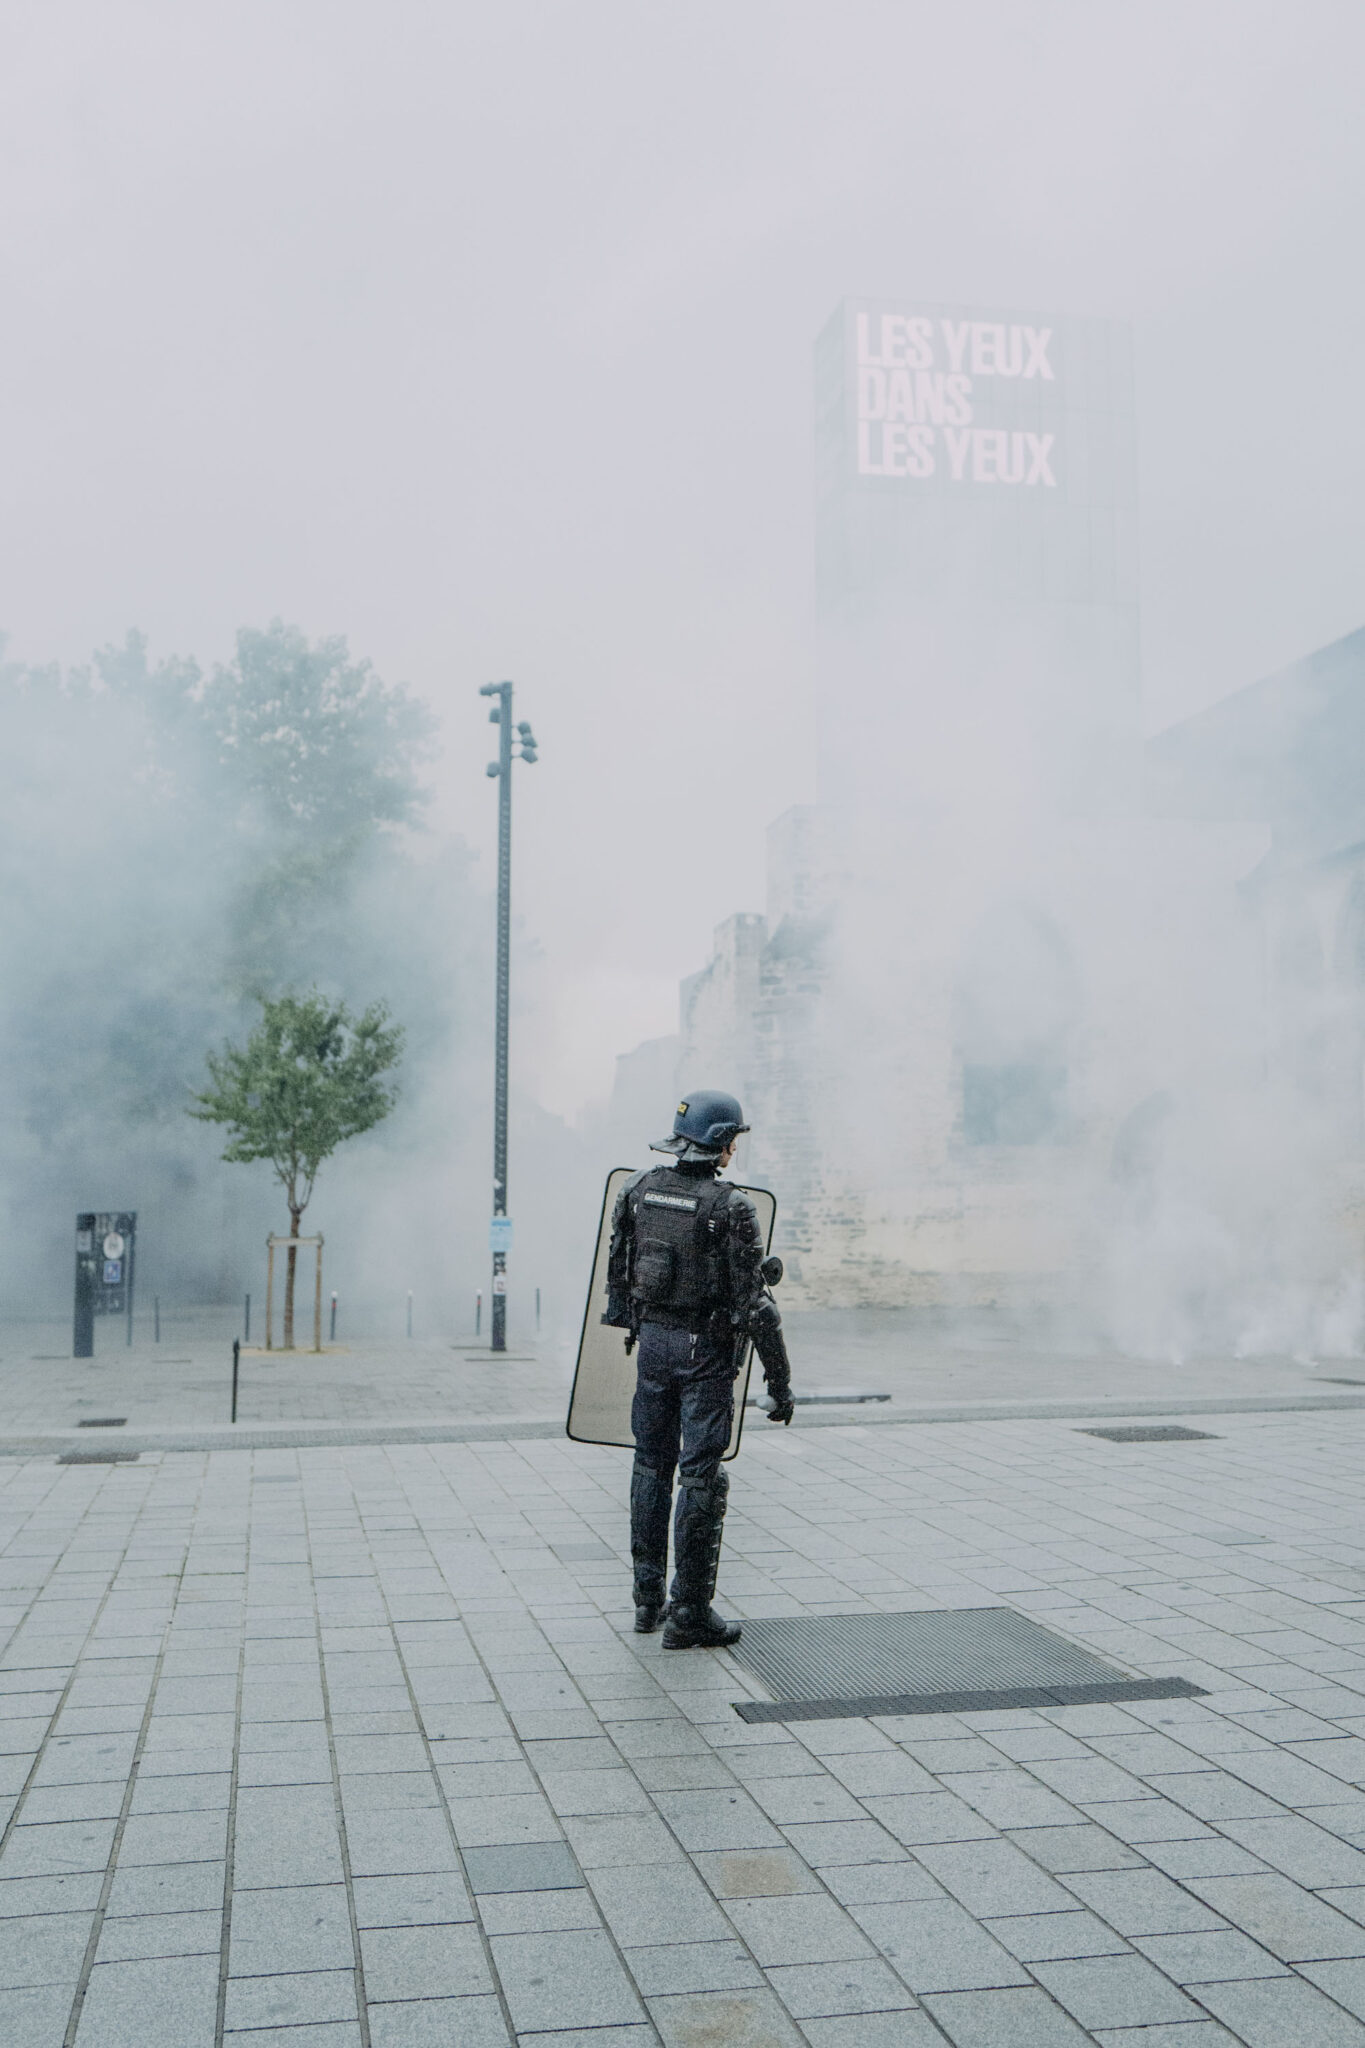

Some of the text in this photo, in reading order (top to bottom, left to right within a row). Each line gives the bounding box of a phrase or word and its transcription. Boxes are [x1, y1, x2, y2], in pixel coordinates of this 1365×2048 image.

[857, 313, 1054, 380] LES YEUX
[858, 367, 972, 426] DANS
[858, 421, 1056, 487] LES YEUX
[644, 1193, 697, 1208] GENDARMERIE
